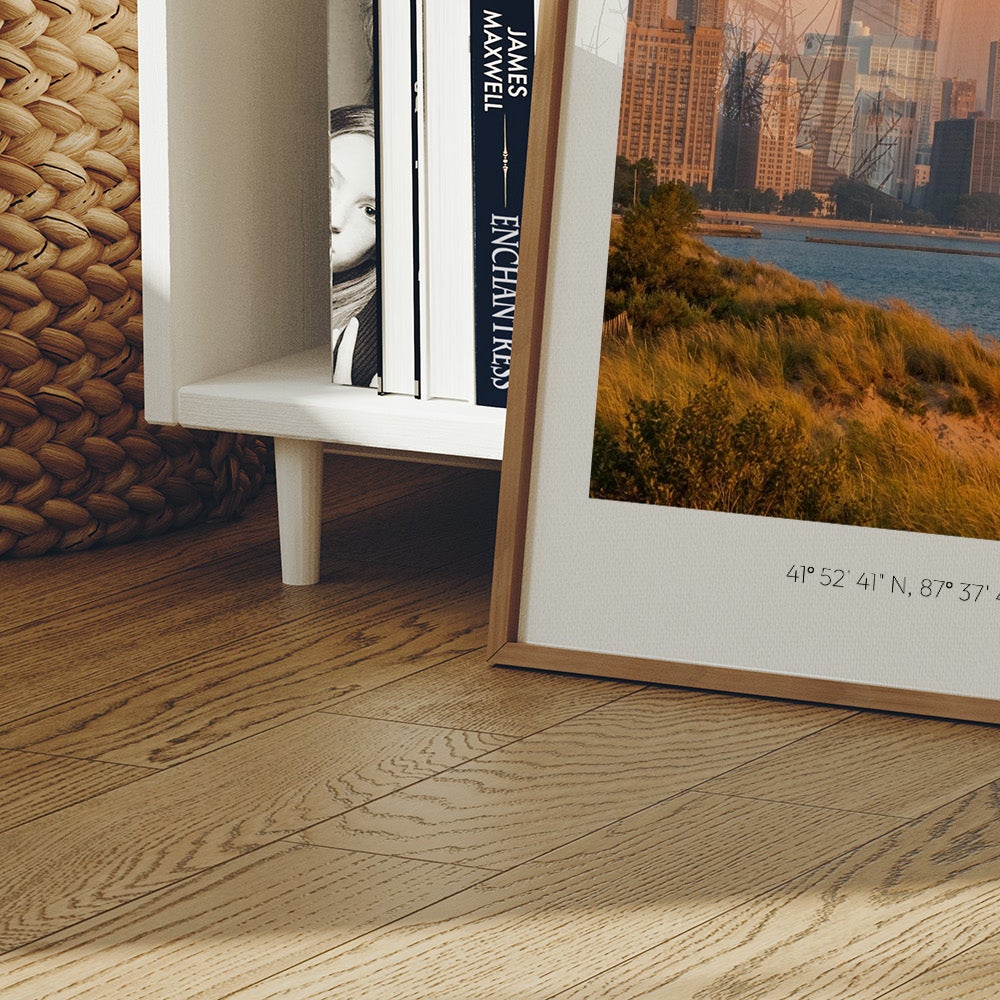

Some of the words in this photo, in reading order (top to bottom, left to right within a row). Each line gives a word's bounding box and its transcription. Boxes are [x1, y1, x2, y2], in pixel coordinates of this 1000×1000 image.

[483, 9, 503, 112] MAXWELL
[507, 26, 528, 98] JAMES
[490, 213, 520, 390] ENCHANTRESS
[786, 564, 815, 584] 41°
[891, 575, 912, 598] N,
[919, 578, 954, 598] 87°
